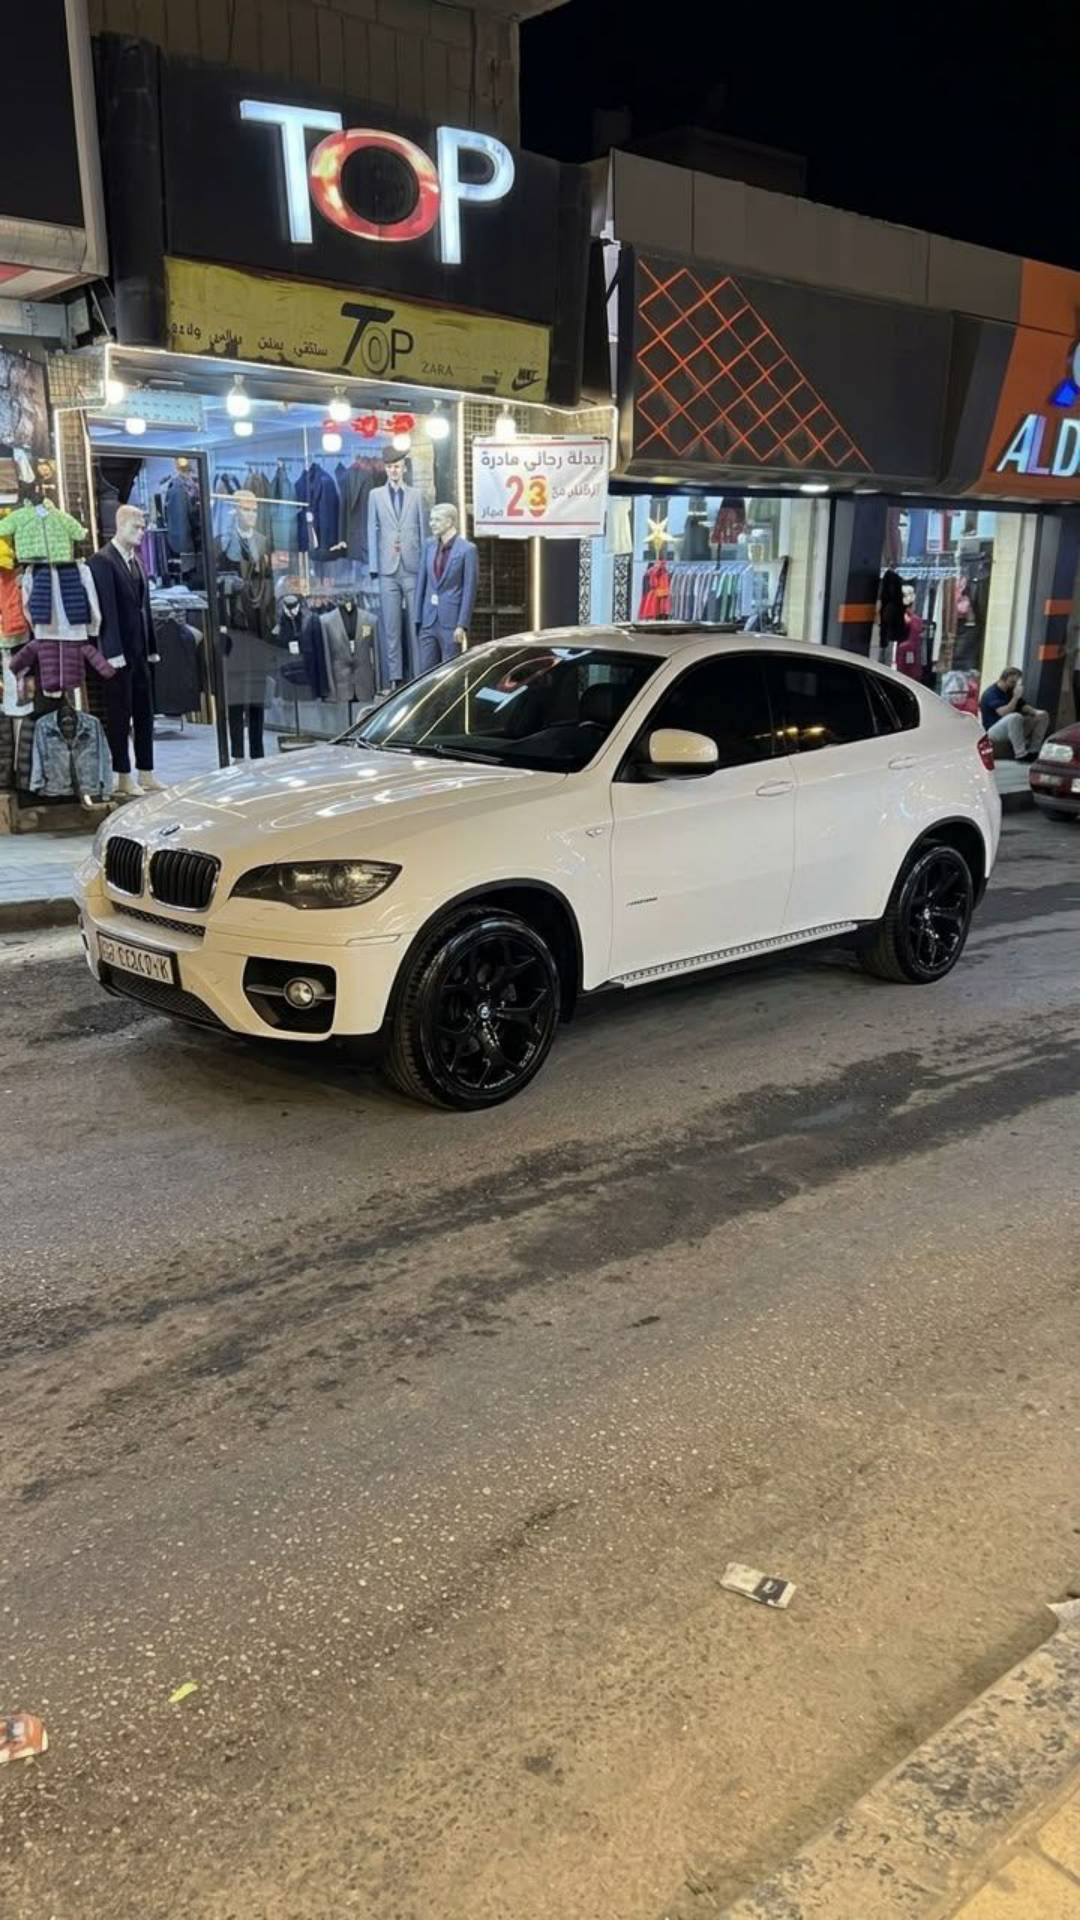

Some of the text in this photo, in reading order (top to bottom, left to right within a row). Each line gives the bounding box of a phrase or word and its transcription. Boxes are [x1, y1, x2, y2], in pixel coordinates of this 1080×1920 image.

[240, 99, 515, 264] TOP
[340, 302, 414, 376] TOP
[421, 360, 455, 378] ZARA
